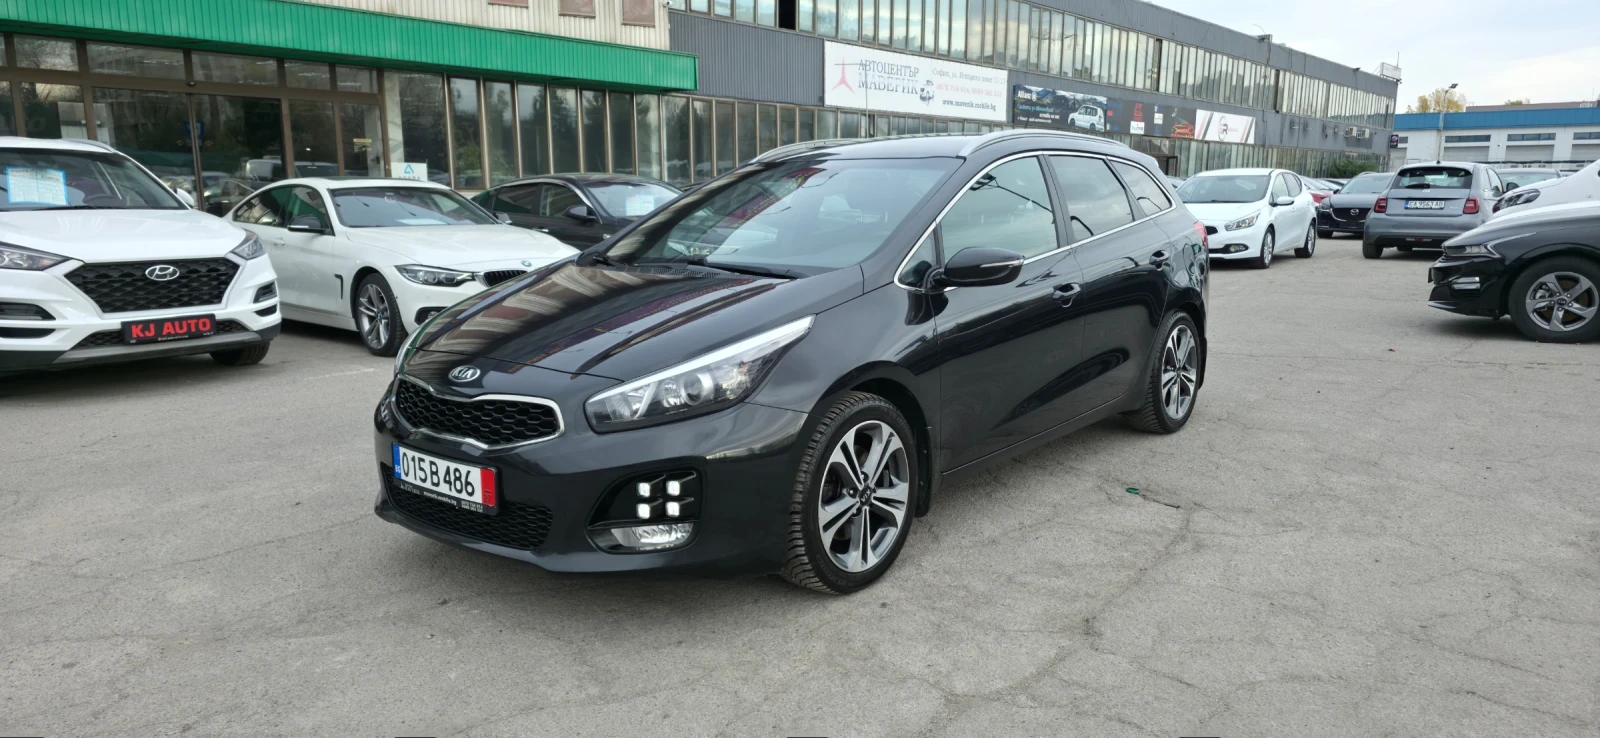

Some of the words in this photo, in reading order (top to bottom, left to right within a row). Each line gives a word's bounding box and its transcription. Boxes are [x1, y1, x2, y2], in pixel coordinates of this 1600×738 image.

[858, 59, 920, 78] АВТОЦЕНТЪР
[858, 72, 919, 95] МАВЕРИК
[131, 322, 155, 338] KJ
[162, 317, 211, 335] AUTO
[451, 366, 475, 379] KIA
